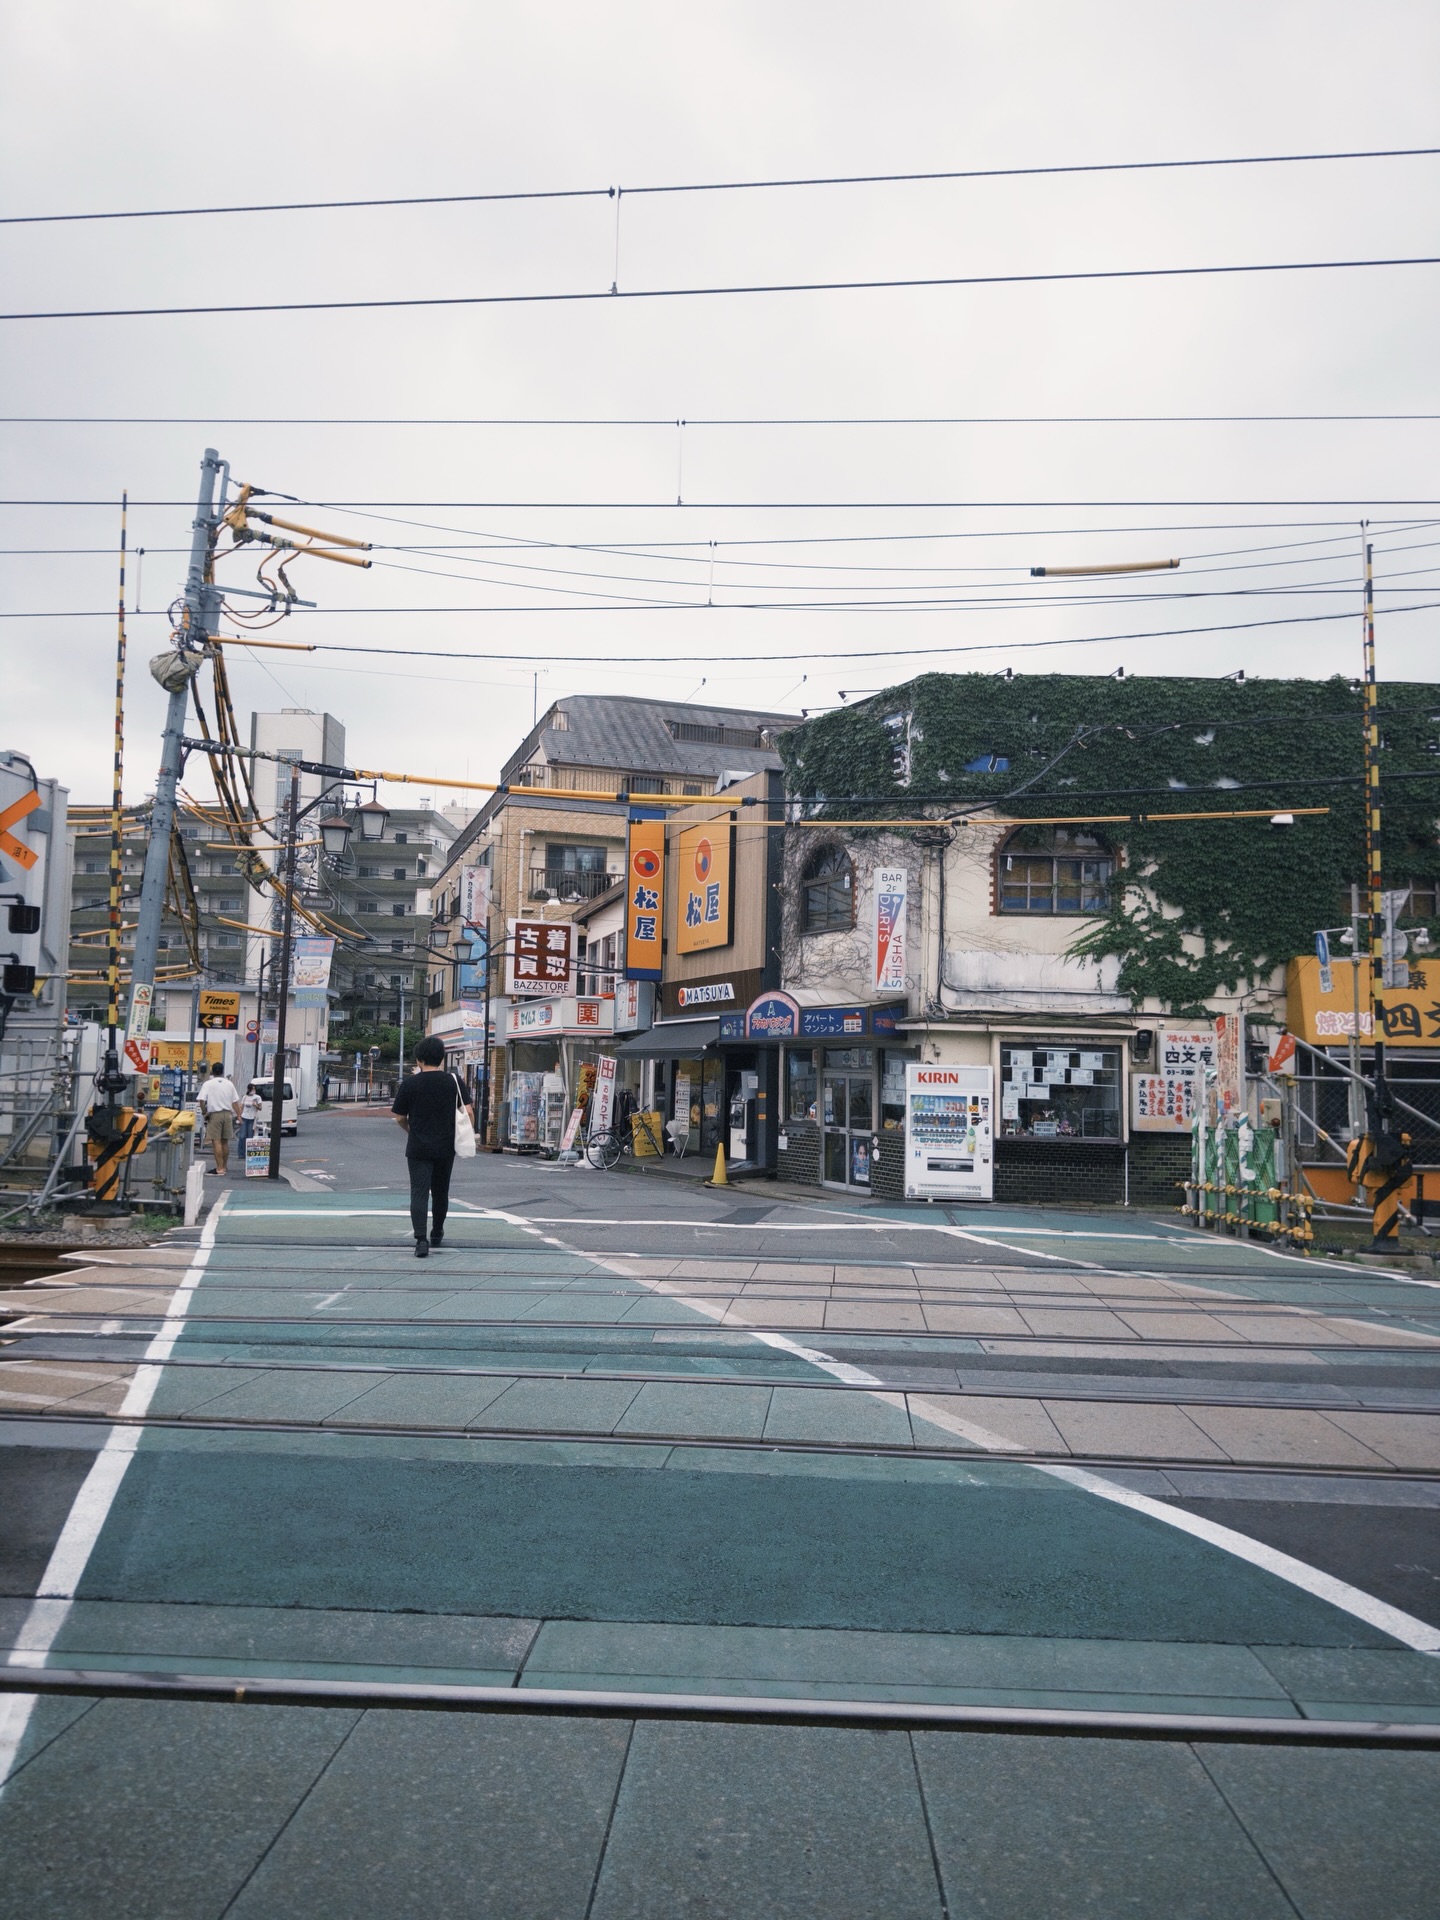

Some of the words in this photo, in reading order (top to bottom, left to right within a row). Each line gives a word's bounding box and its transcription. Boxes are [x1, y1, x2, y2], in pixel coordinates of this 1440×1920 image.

[881, 873, 902, 882] BAR
[886, 884, 897, 892] 2F
[685, 881, 721, 928] 松屋
[633, 885, 659, 941] 松屋
[879, 895, 890, 943] DARTS
[519, 927, 567, 951] 古着
[518, 955, 566, 977] 買取
[891, 935, 903, 988] SHISHA
[513, 980, 569, 992] BAZZSTORE
[686, 984, 731, 1003] MATSUYA
[204, 995, 236, 1006] Times
[520, 1010, 536, 1026] セイムス
[578, 1003, 598, 1024] 薬
[804, 1014, 835, 1023] アパート
[225, 1015, 236, 1029] P
[804, 1024, 843, 1033] マンション
[1191, 1034, 1214, 1044] 焼とり
[1165, 1050, 1215, 1066] 四文屋
[917, 1072, 959, 1084] KIRIN
